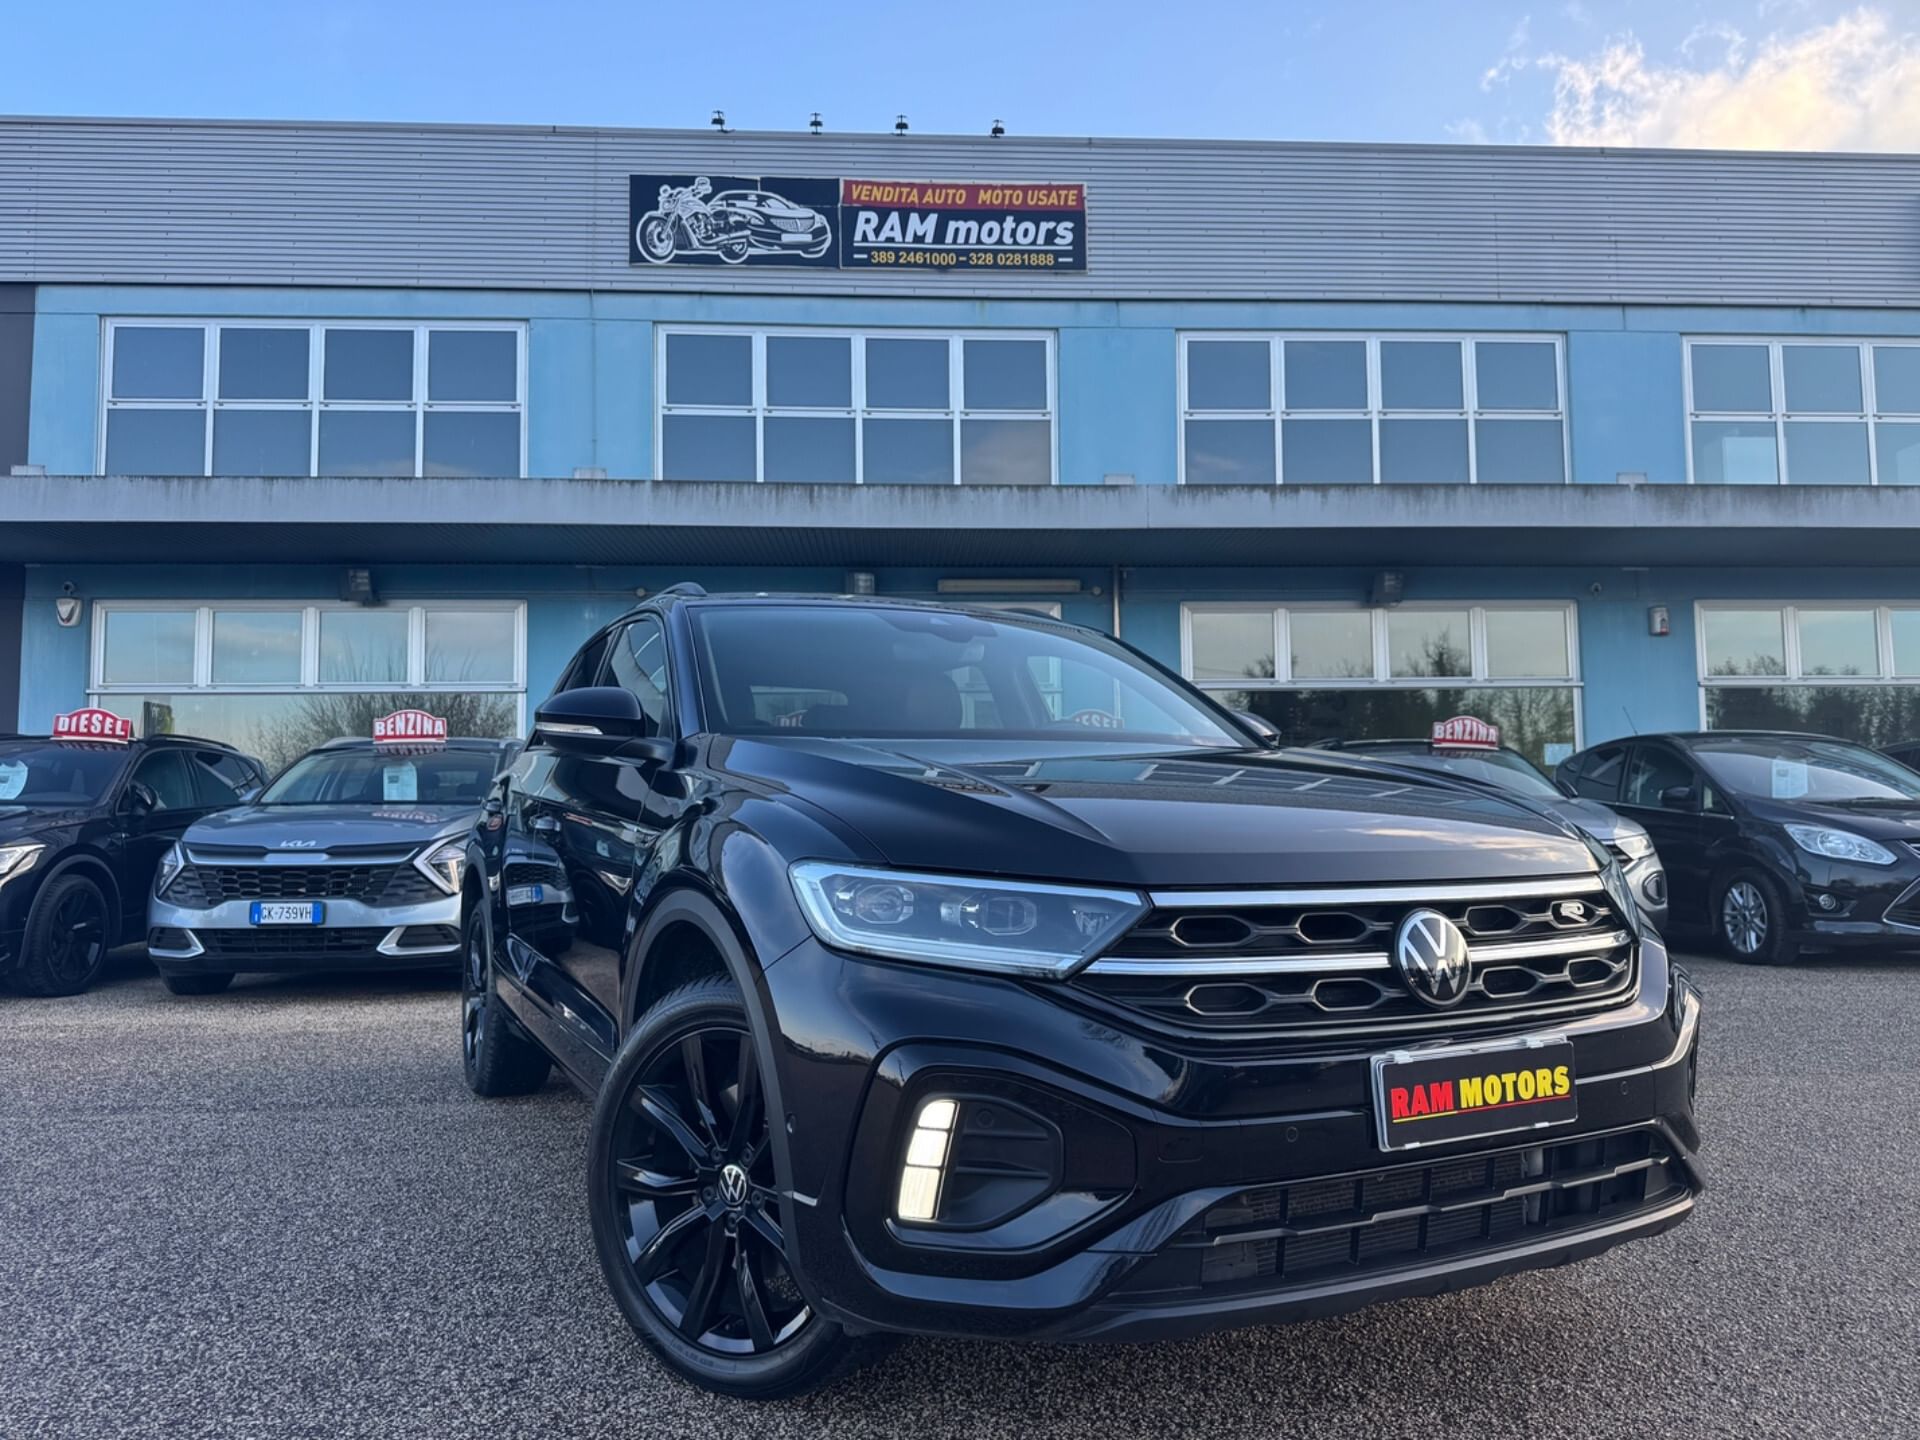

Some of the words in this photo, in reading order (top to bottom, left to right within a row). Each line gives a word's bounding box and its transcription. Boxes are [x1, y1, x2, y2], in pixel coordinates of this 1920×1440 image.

[852, 184, 919, 203] VENDITA
[922, 188, 967, 205] AUTO
[978, 189, 1023, 206] MOTO
[1027, 190, 1078, 206] USATE
[853, 210, 938, 243] RAM
[944, 215, 1075, 246] motors
[871, 251, 895, 264] 389
[898, 251, 957, 266] 2461000
[969, 252, 994, 266] 328
[997, 253, 1055, 266] 0281888
[57, 713, 126, 736] DIESEL
[375, 712, 445, 736] BENZINA
[1433, 719, 1497, 742] BENZINA
[1390, 1080, 1455, 1119] RAM
[1458, 1065, 1571, 1109] MOTORS
